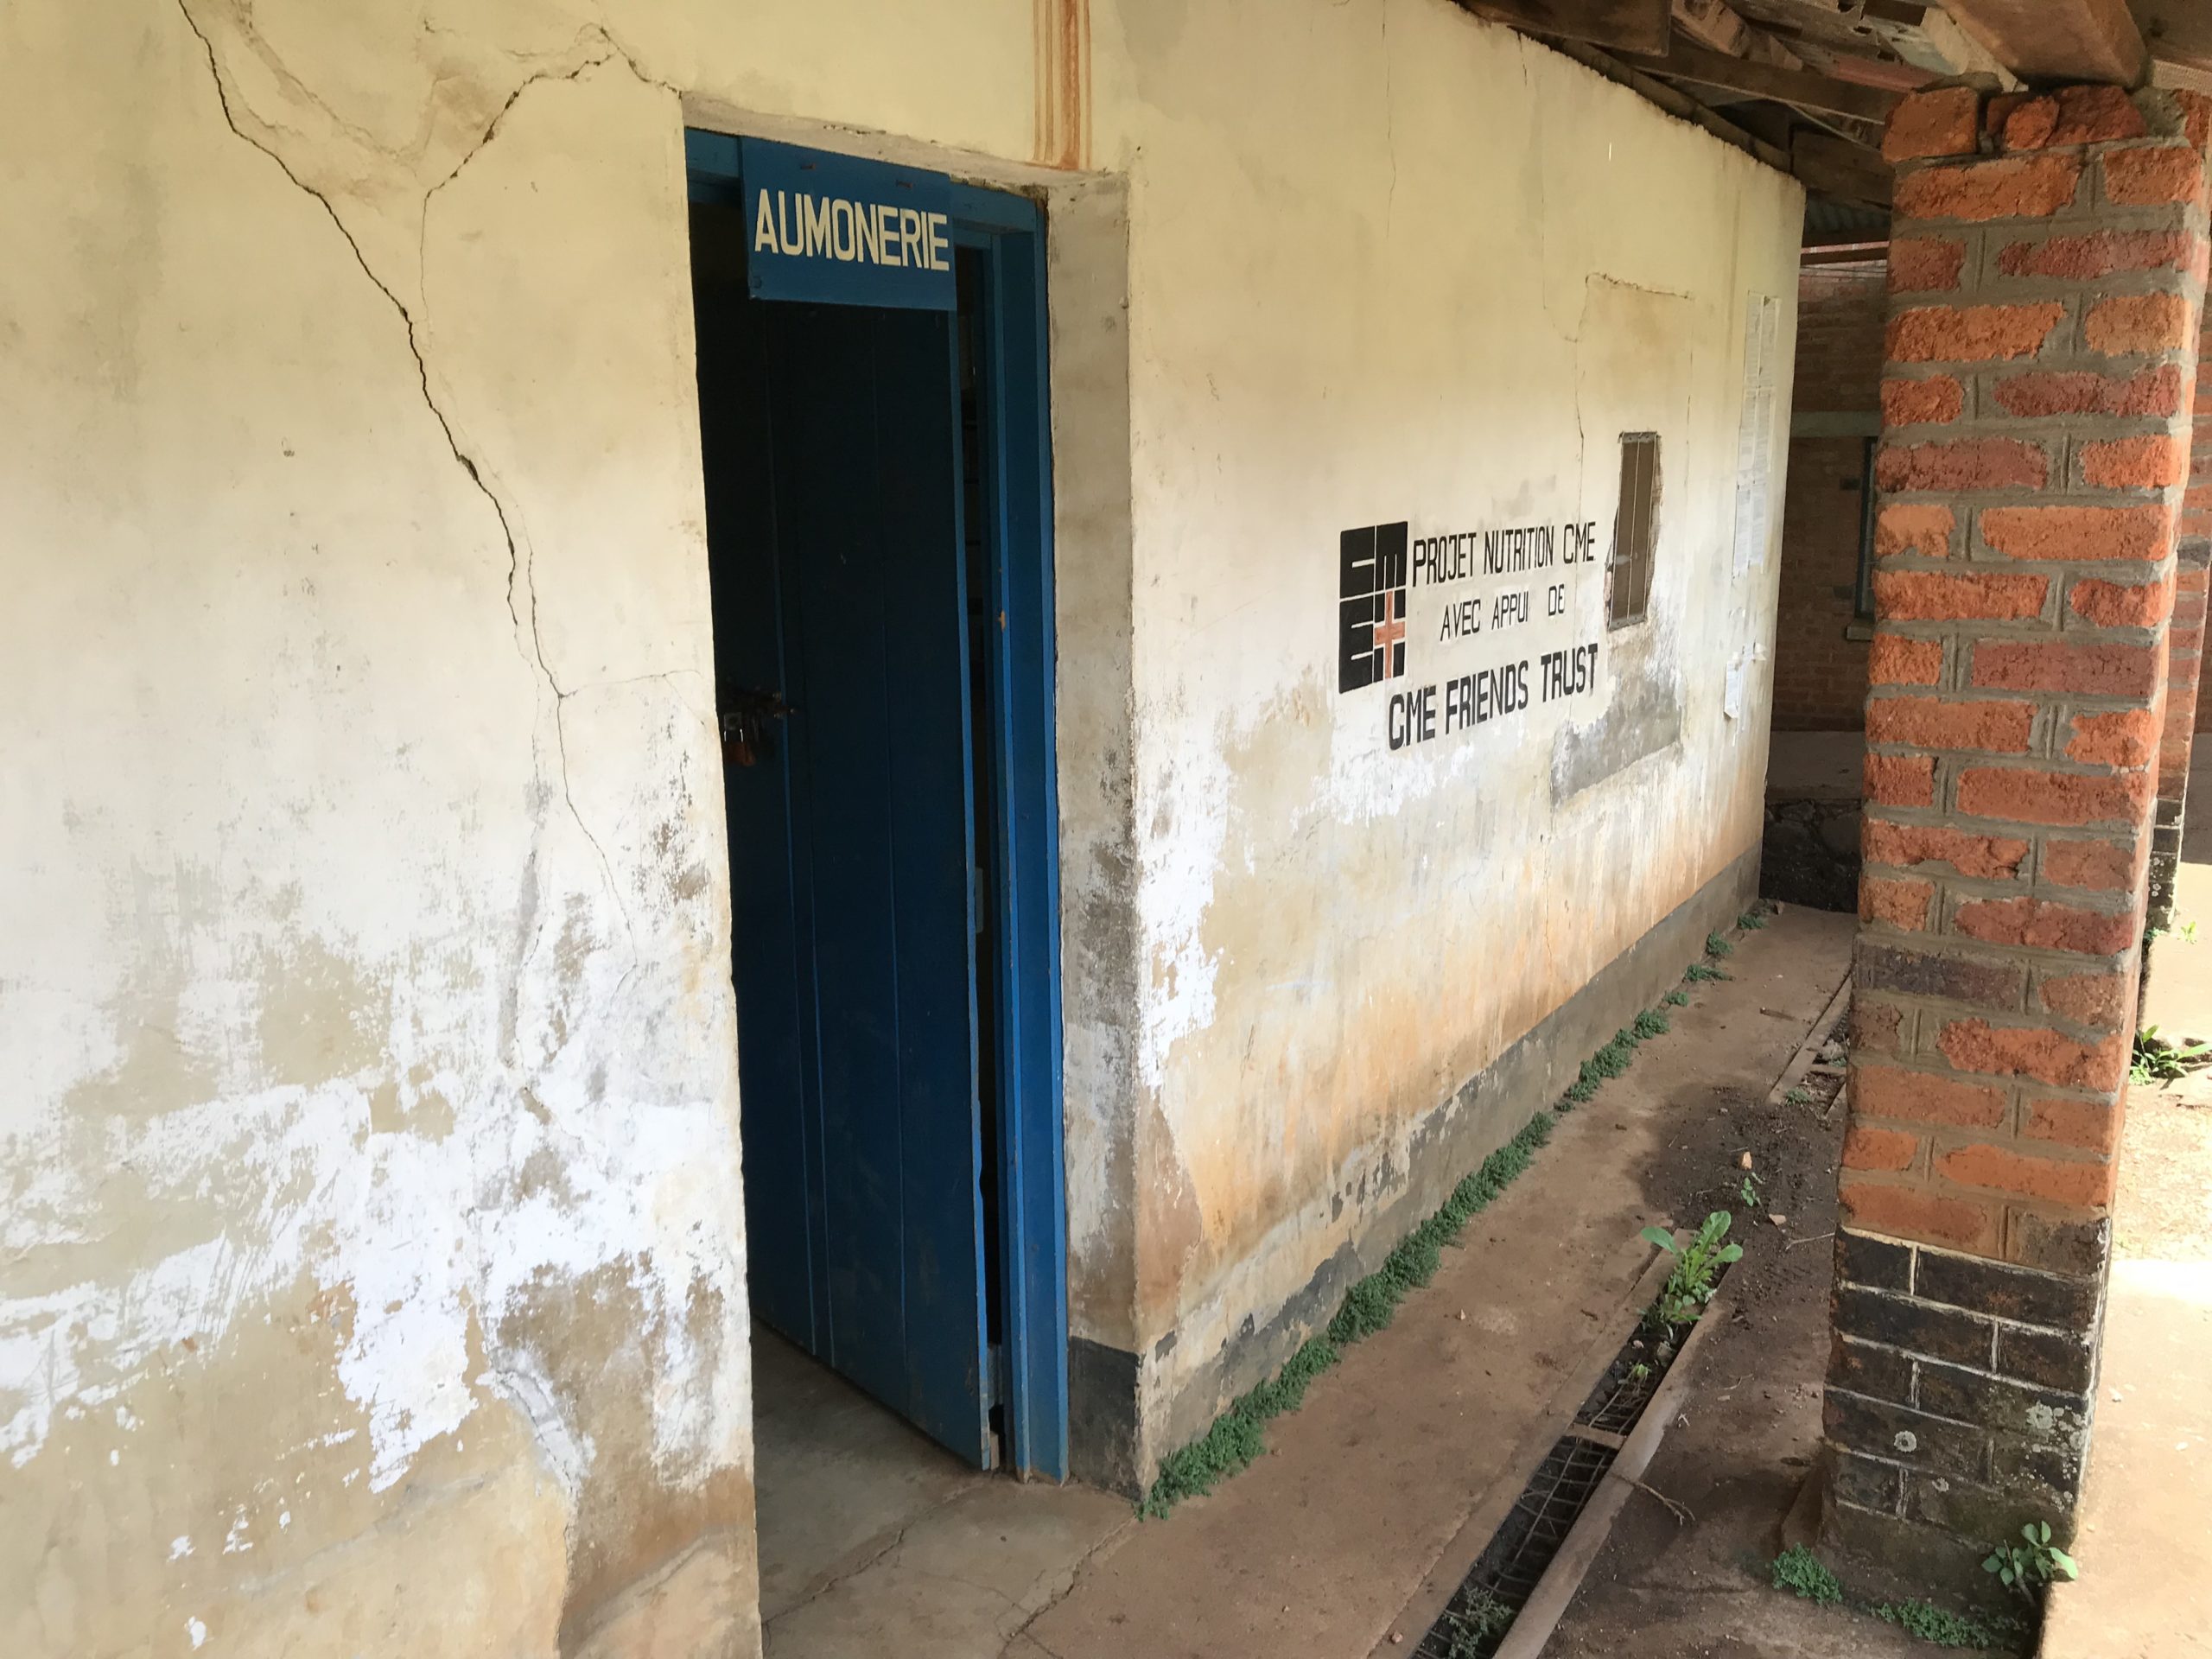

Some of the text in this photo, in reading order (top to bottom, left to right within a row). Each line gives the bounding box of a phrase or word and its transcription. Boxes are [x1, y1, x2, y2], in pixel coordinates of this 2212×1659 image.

[754, 188, 950, 271] AUMONERIE
[1412, 521, 1596, 588] PROJET NUTRITION CME
[1440, 583, 1565, 641] AVEC APPUI DE
[1389, 643, 1599, 751] CME FRIENDS TRUST
